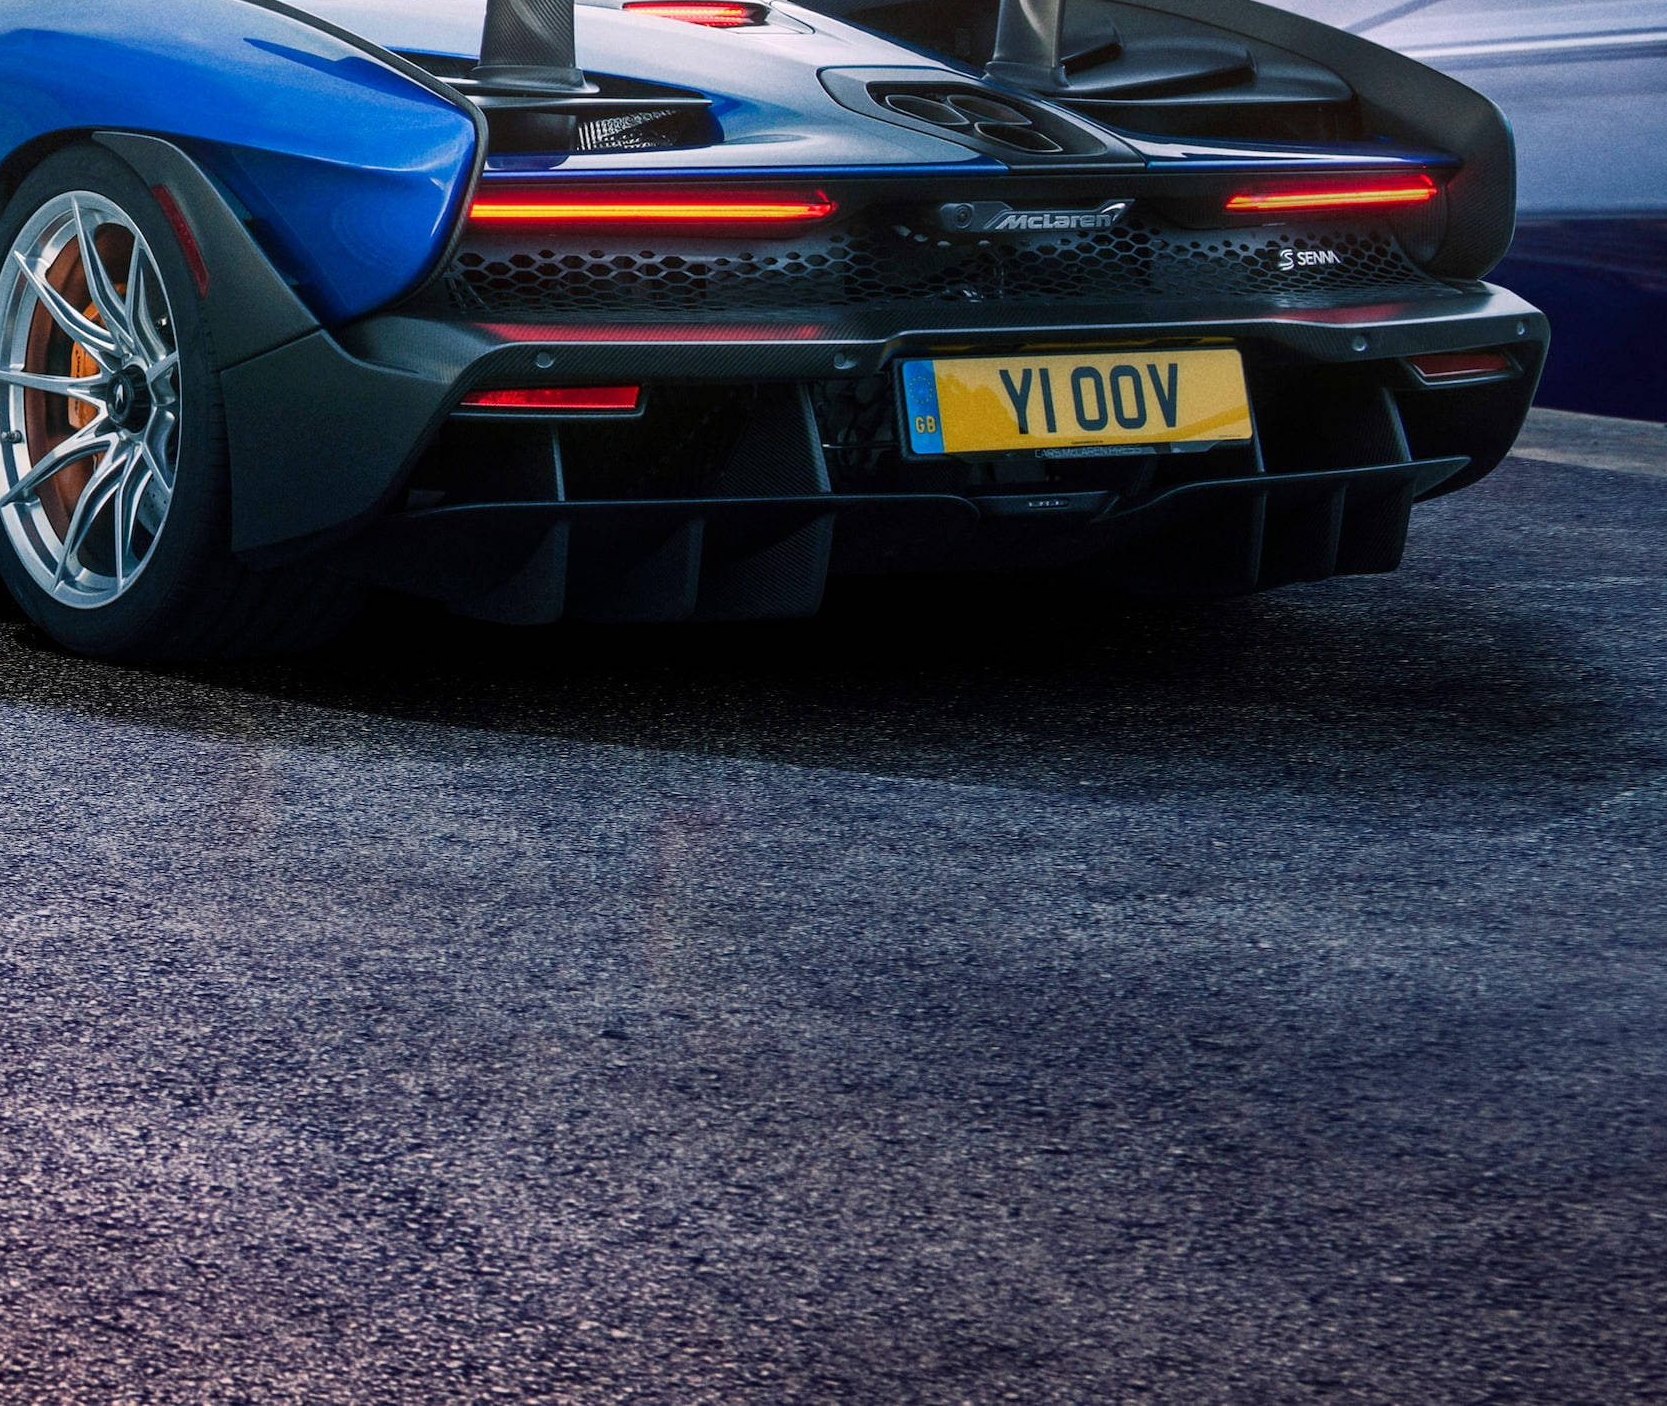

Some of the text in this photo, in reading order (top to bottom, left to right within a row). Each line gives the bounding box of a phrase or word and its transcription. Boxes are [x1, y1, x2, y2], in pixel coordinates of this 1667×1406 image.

[995, 214, 1111, 230] McLaren
[1296, 250, 1342, 266] SENNA
[915, 416, 936, 434] GB
